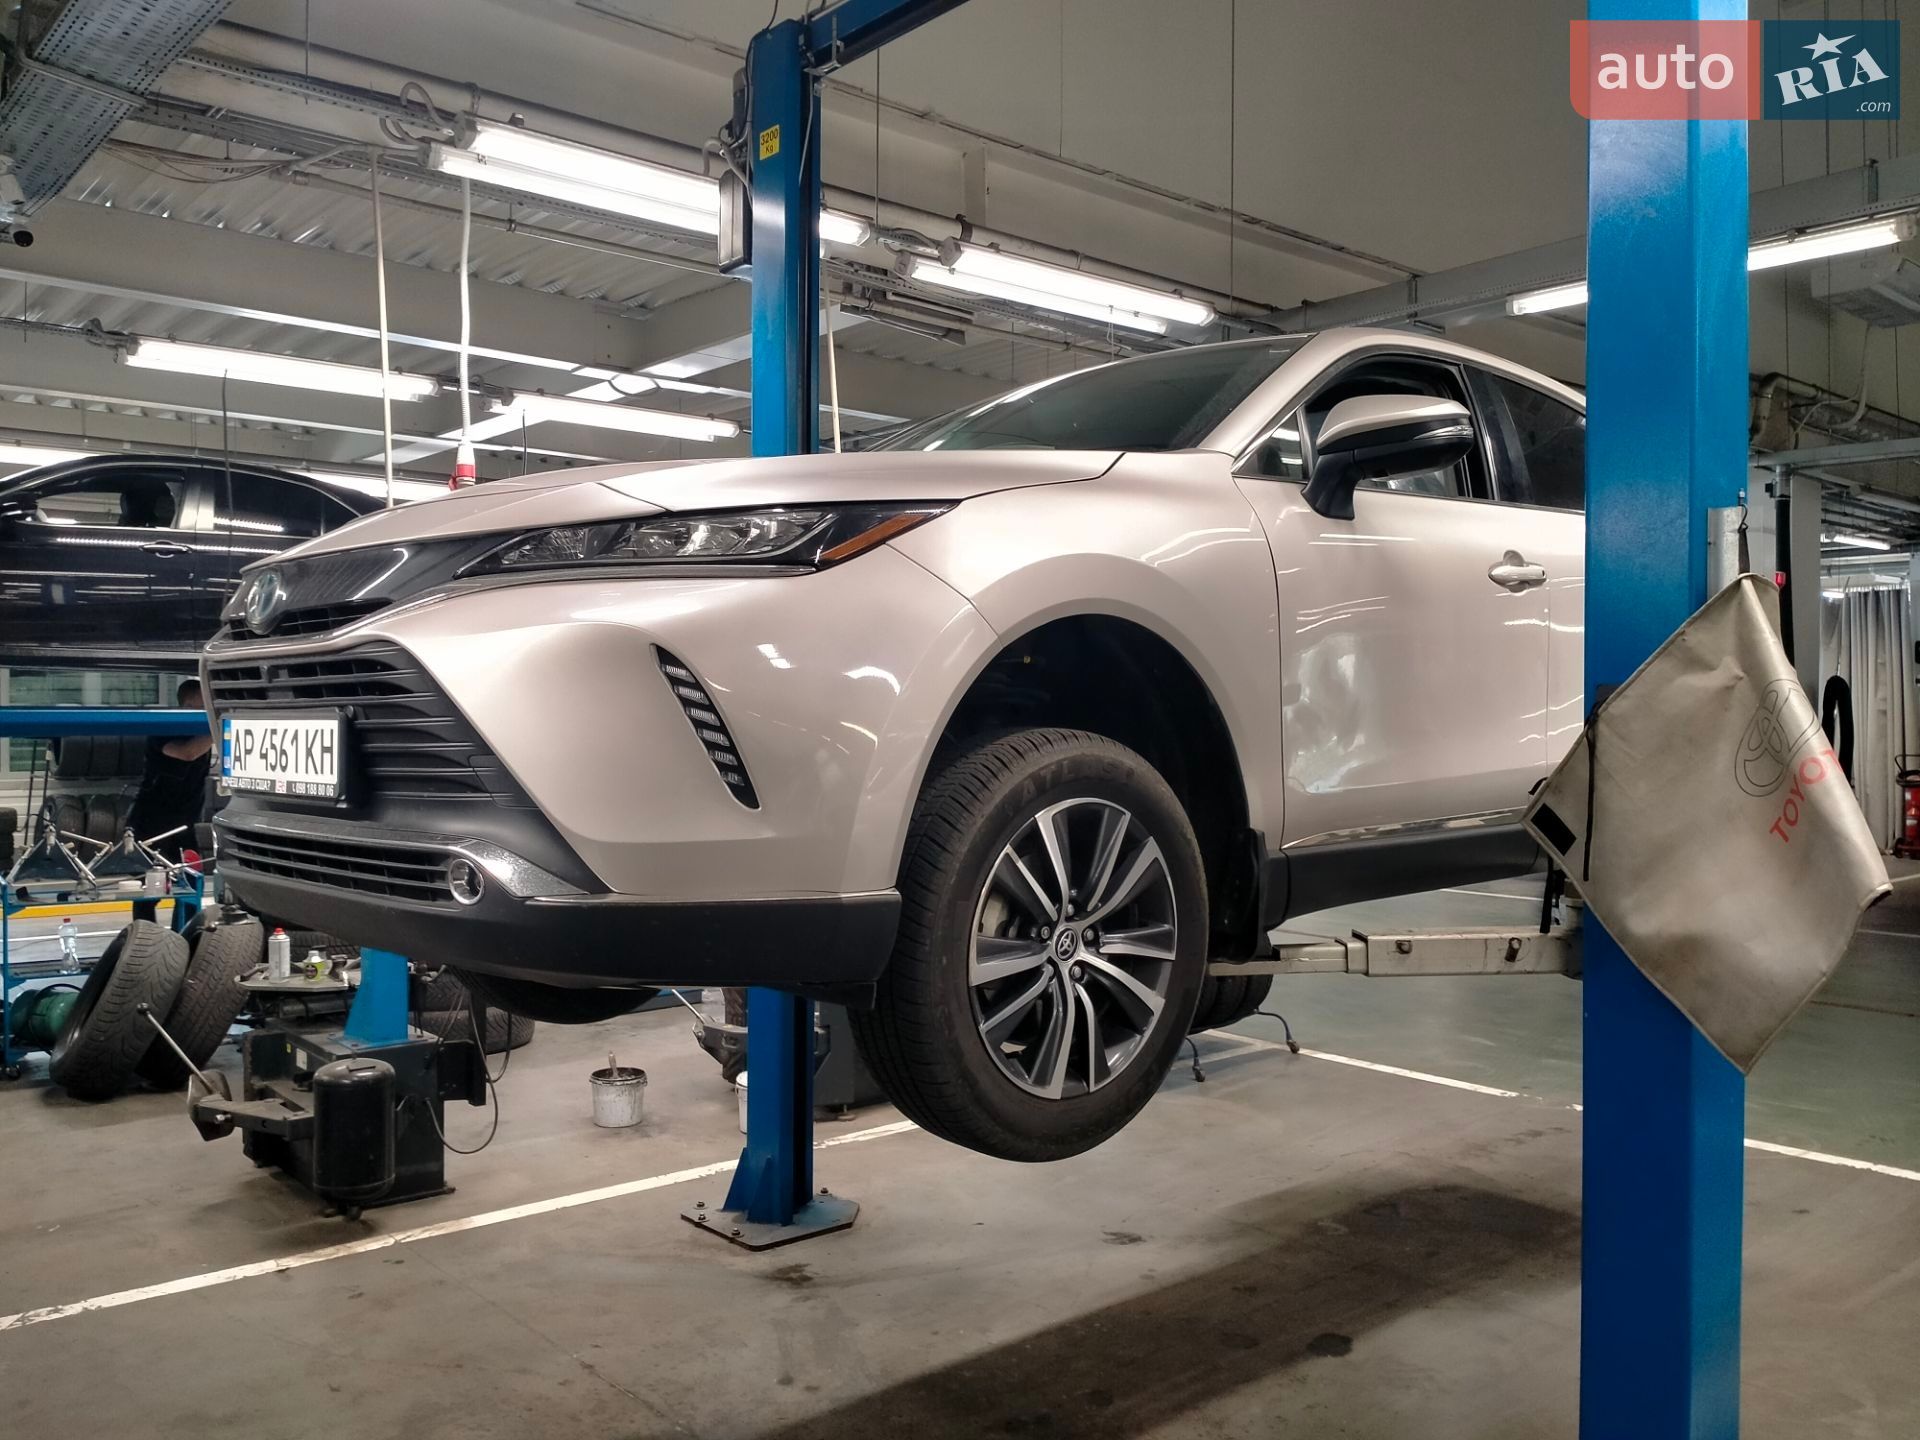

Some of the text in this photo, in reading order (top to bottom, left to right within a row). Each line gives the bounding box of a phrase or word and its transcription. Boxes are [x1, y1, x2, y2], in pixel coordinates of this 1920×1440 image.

[761, 128, 778, 145] 3200
[233, 728, 334, 776] AP 4561 KH
